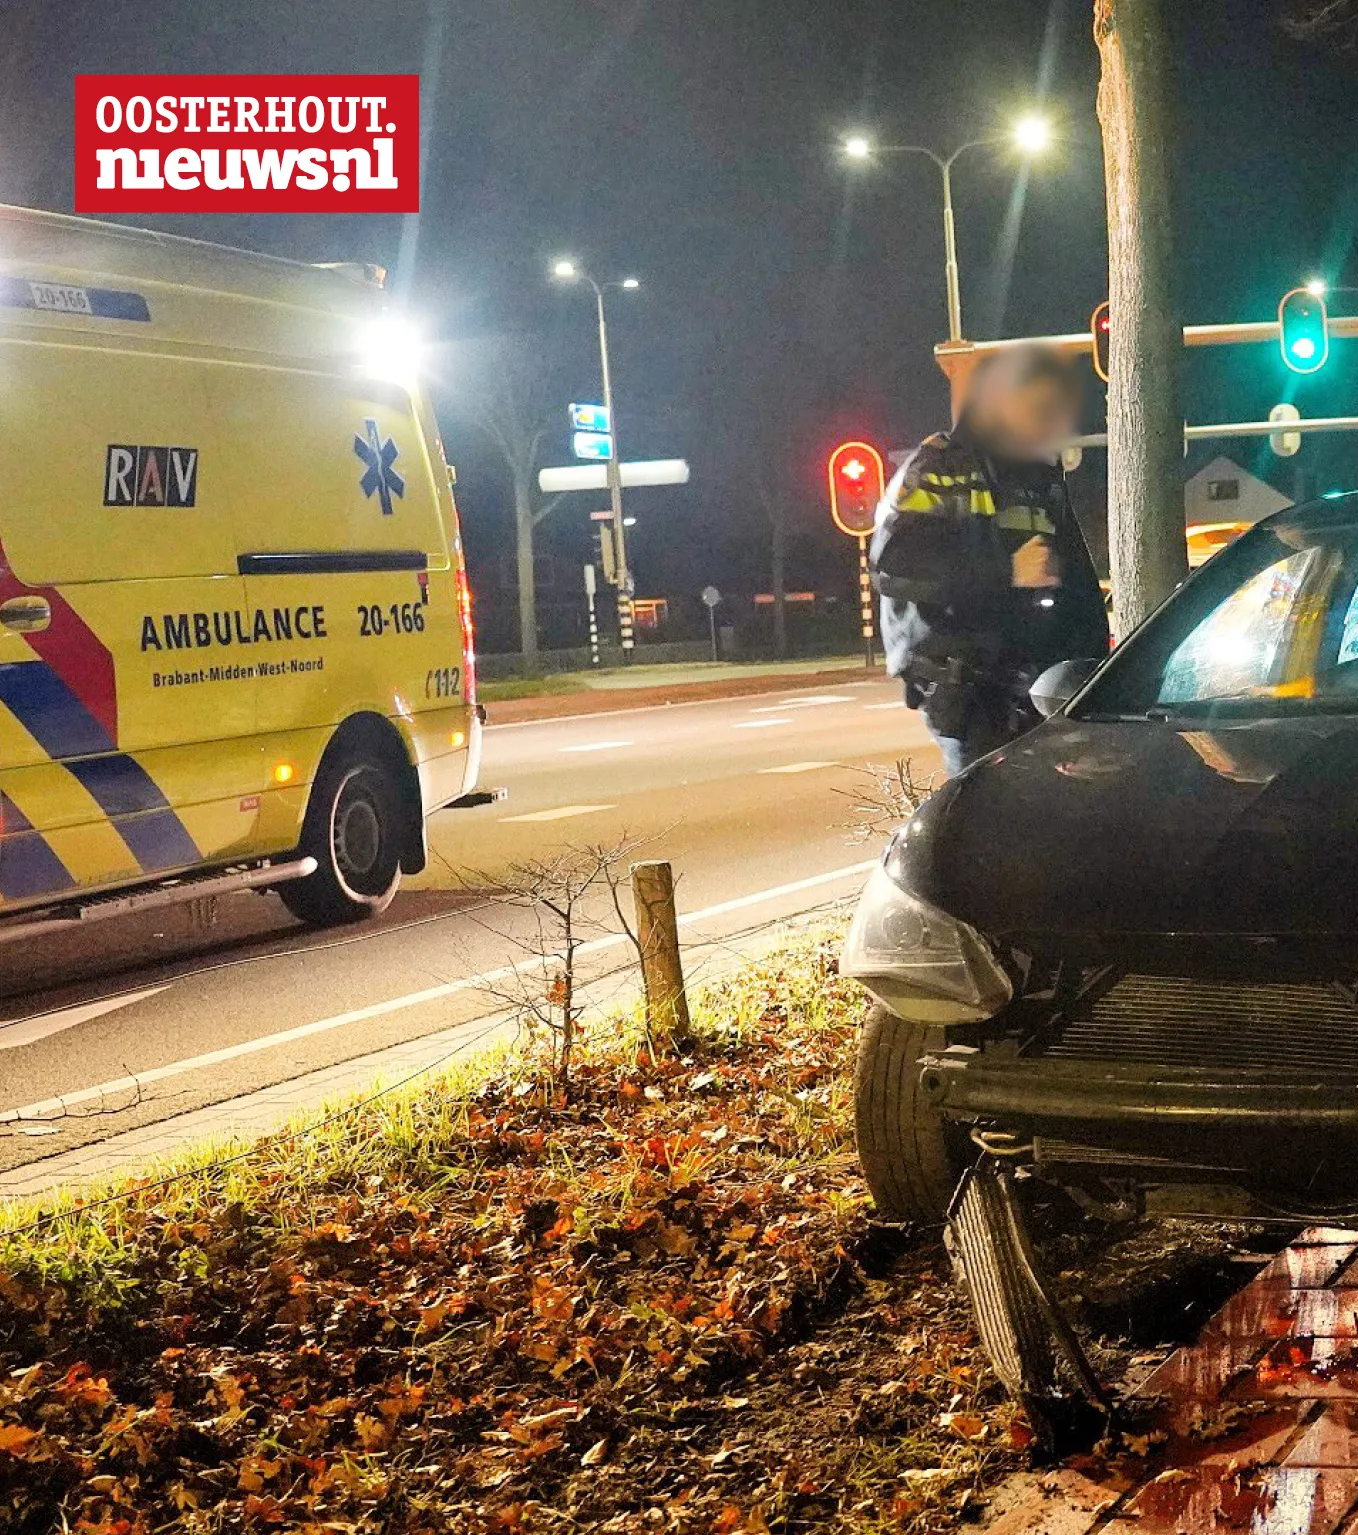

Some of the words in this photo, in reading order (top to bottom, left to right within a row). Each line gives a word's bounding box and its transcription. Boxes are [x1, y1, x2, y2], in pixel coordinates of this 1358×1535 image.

[108, 448, 197, 503] RAV
[140, 606, 328, 652] AMBULANCE
[357, 601, 425, 637] 20-166
